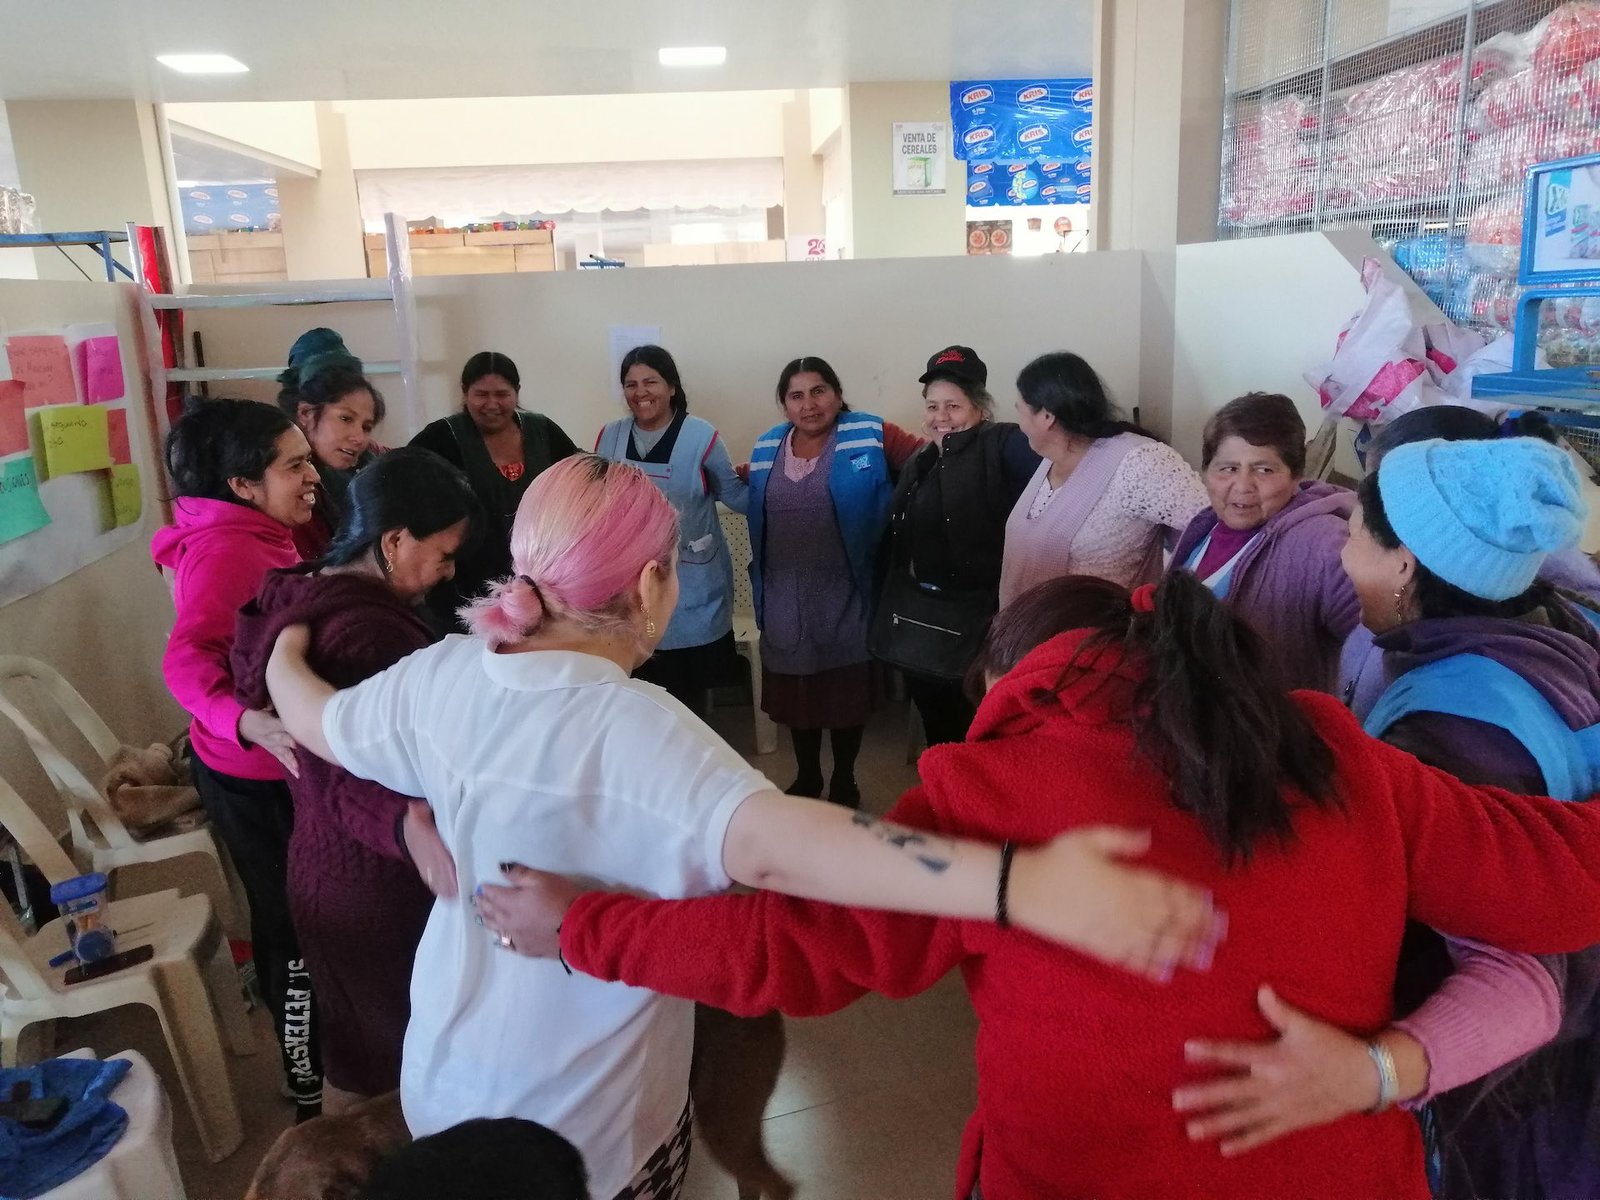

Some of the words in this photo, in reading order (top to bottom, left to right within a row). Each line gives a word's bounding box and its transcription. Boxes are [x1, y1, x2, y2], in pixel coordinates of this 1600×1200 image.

[967, 90, 988, 102] KRIS
[1023, 89, 1044, 100] KRIS
[1078, 88, 1093, 100] KRI
[902, 133, 925, 143] VENTA
[926, 133, 936, 143] DE
[969, 129, 989, 141] KRIS
[1024, 128, 1044, 140] KRIS
[901, 144, 937, 155] CEREALES
